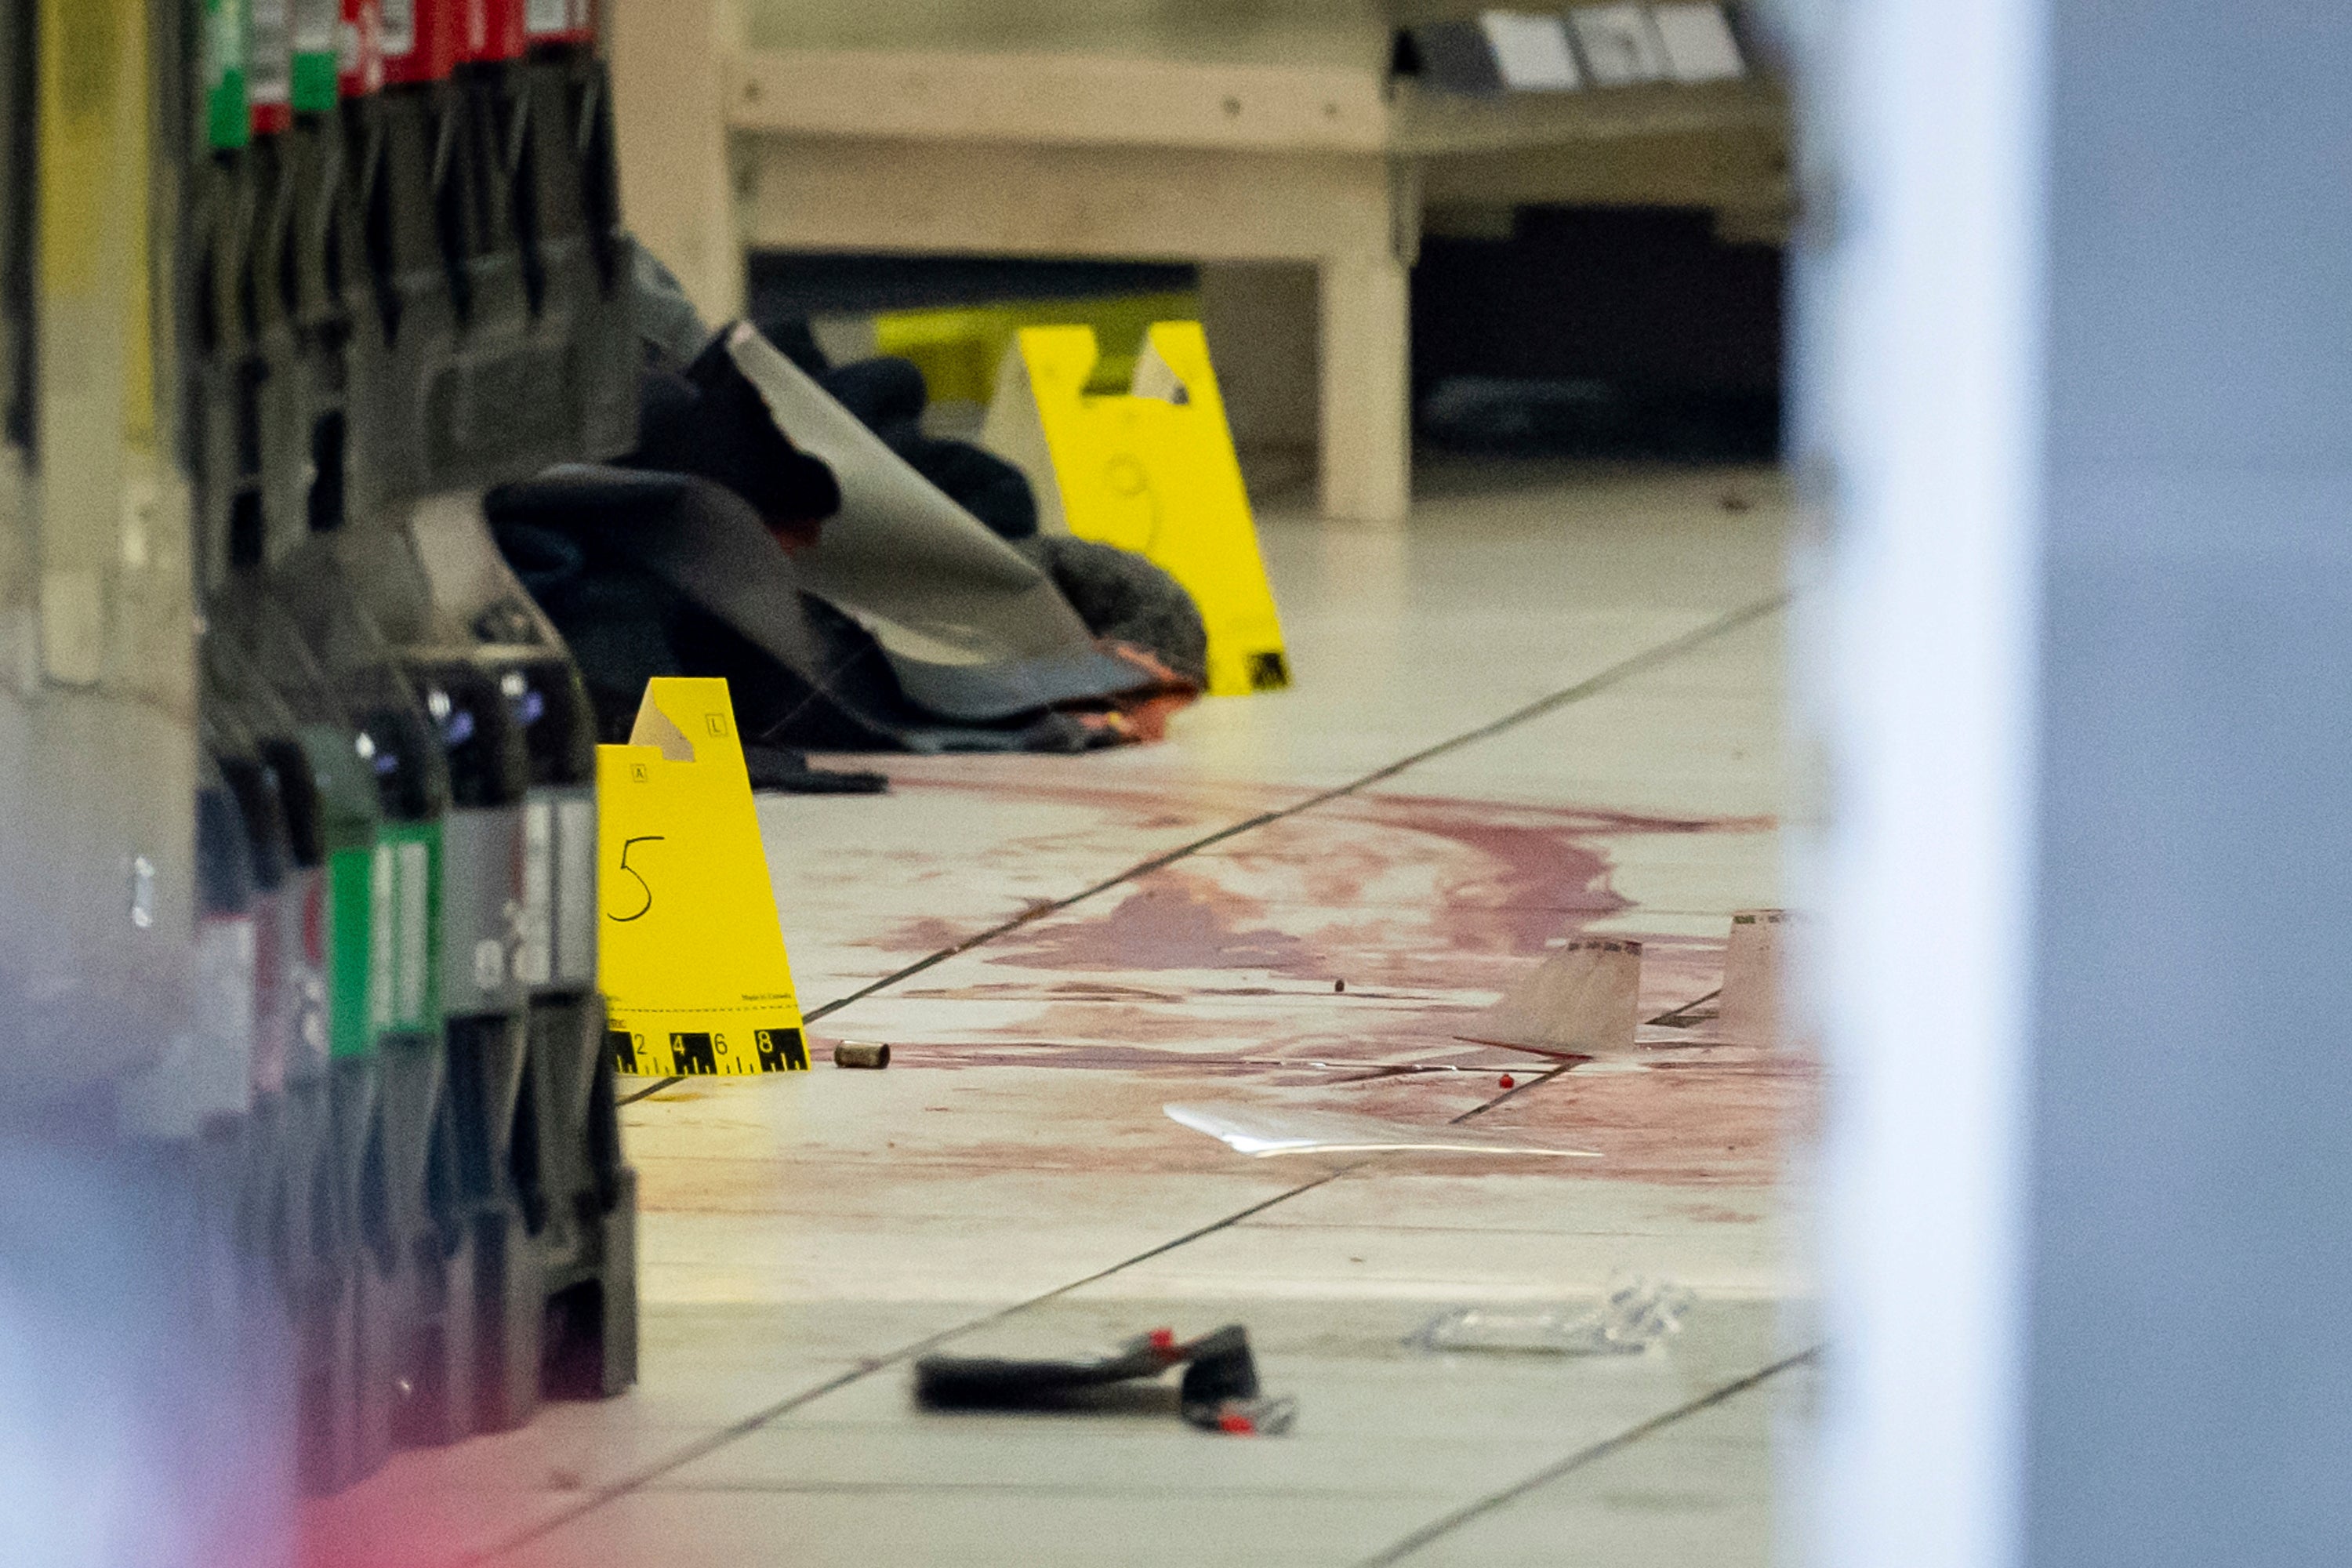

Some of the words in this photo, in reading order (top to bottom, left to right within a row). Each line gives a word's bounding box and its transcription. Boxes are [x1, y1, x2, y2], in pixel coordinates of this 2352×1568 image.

[712, 717, 721, 733] L
[635, 768, 644, 779] A
[606, 836, 666, 922] 5
[634, 1033, 648, 1055] 2
[673, 1035, 685, 1055] 4
[714, 1033, 728, 1055] 6
[757, 1030, 774, 1054] 8
